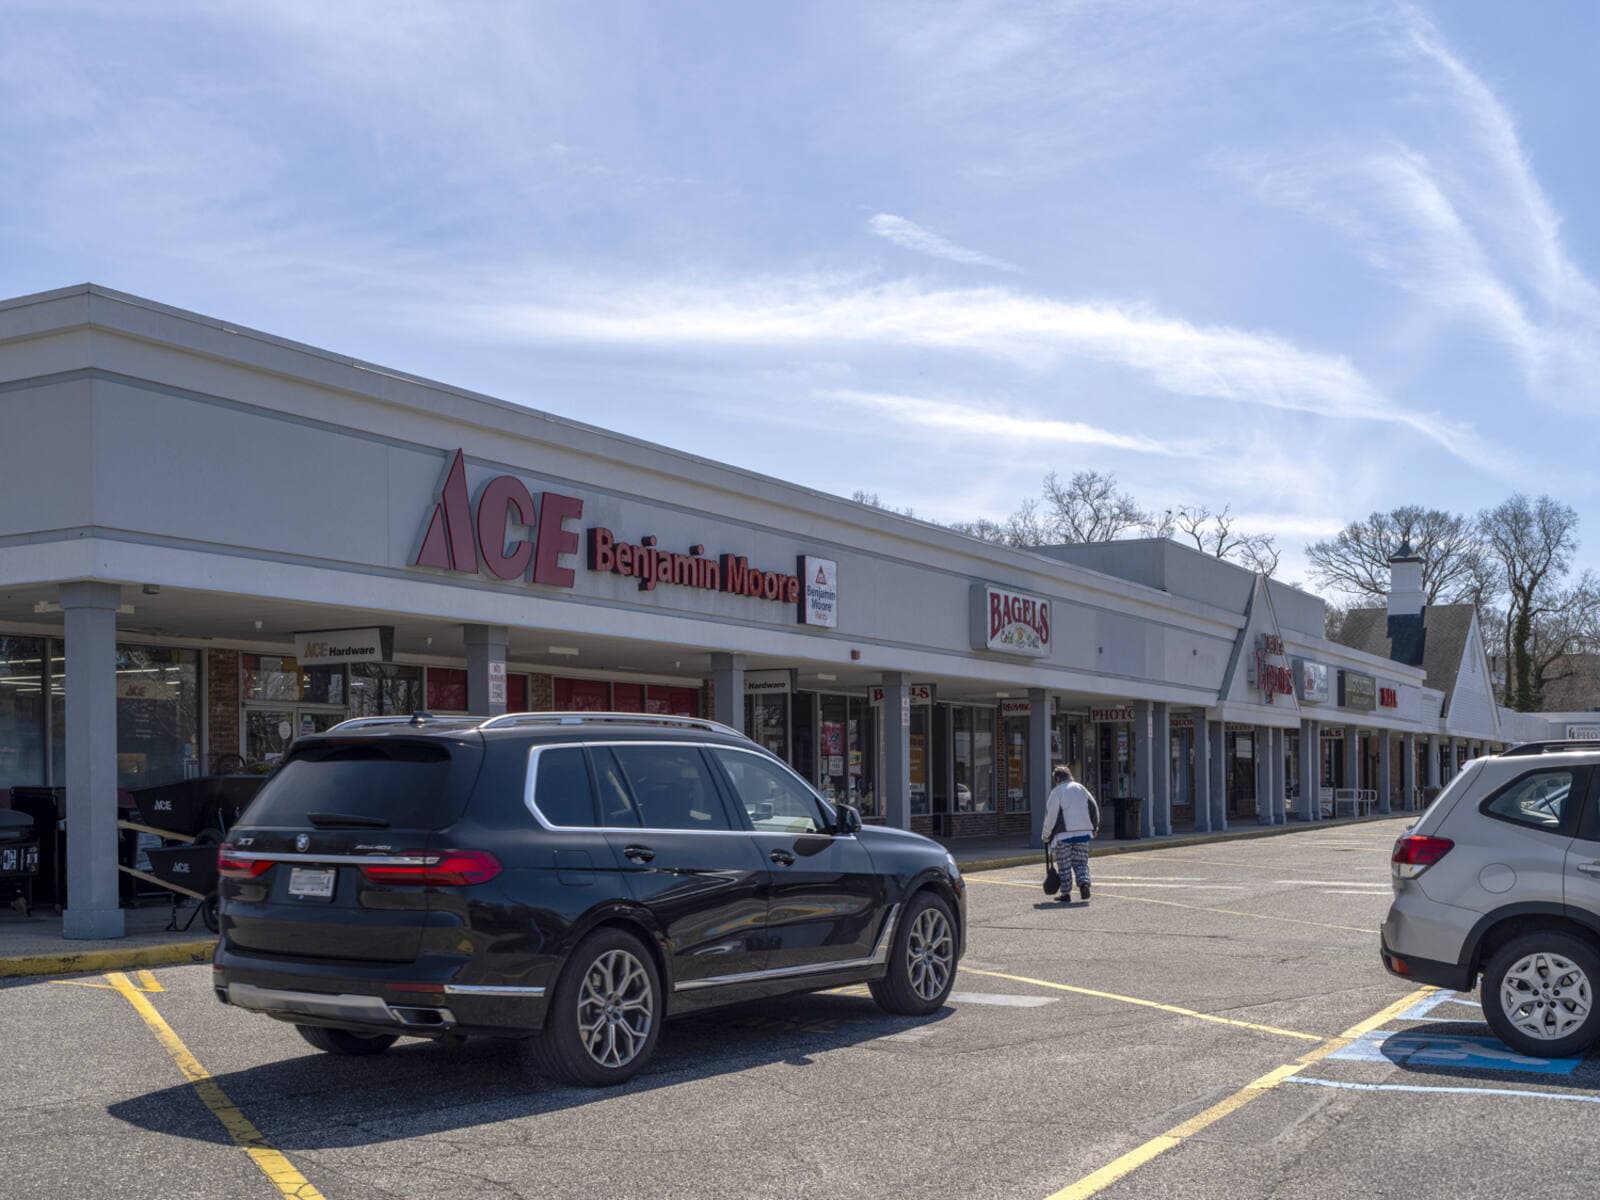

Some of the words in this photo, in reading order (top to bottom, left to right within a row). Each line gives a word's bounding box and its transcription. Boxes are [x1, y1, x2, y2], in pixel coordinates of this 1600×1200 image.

[416, 447, 584, 588] ACE
[589, 527, 721, 591] Benjamin
[722, 554, 800, 603] Moore
[807, 585, 836, 600] Benjamin
[811, 598, 832, 612] Moore
[989, 592, 1049, 645] BAGELS
[304, 641, 329, 659] ACE
[329, 645, 375, 657] Hardware
[154, 799, 172, 811] ACE
[172, 861, 190, 874] ACE
